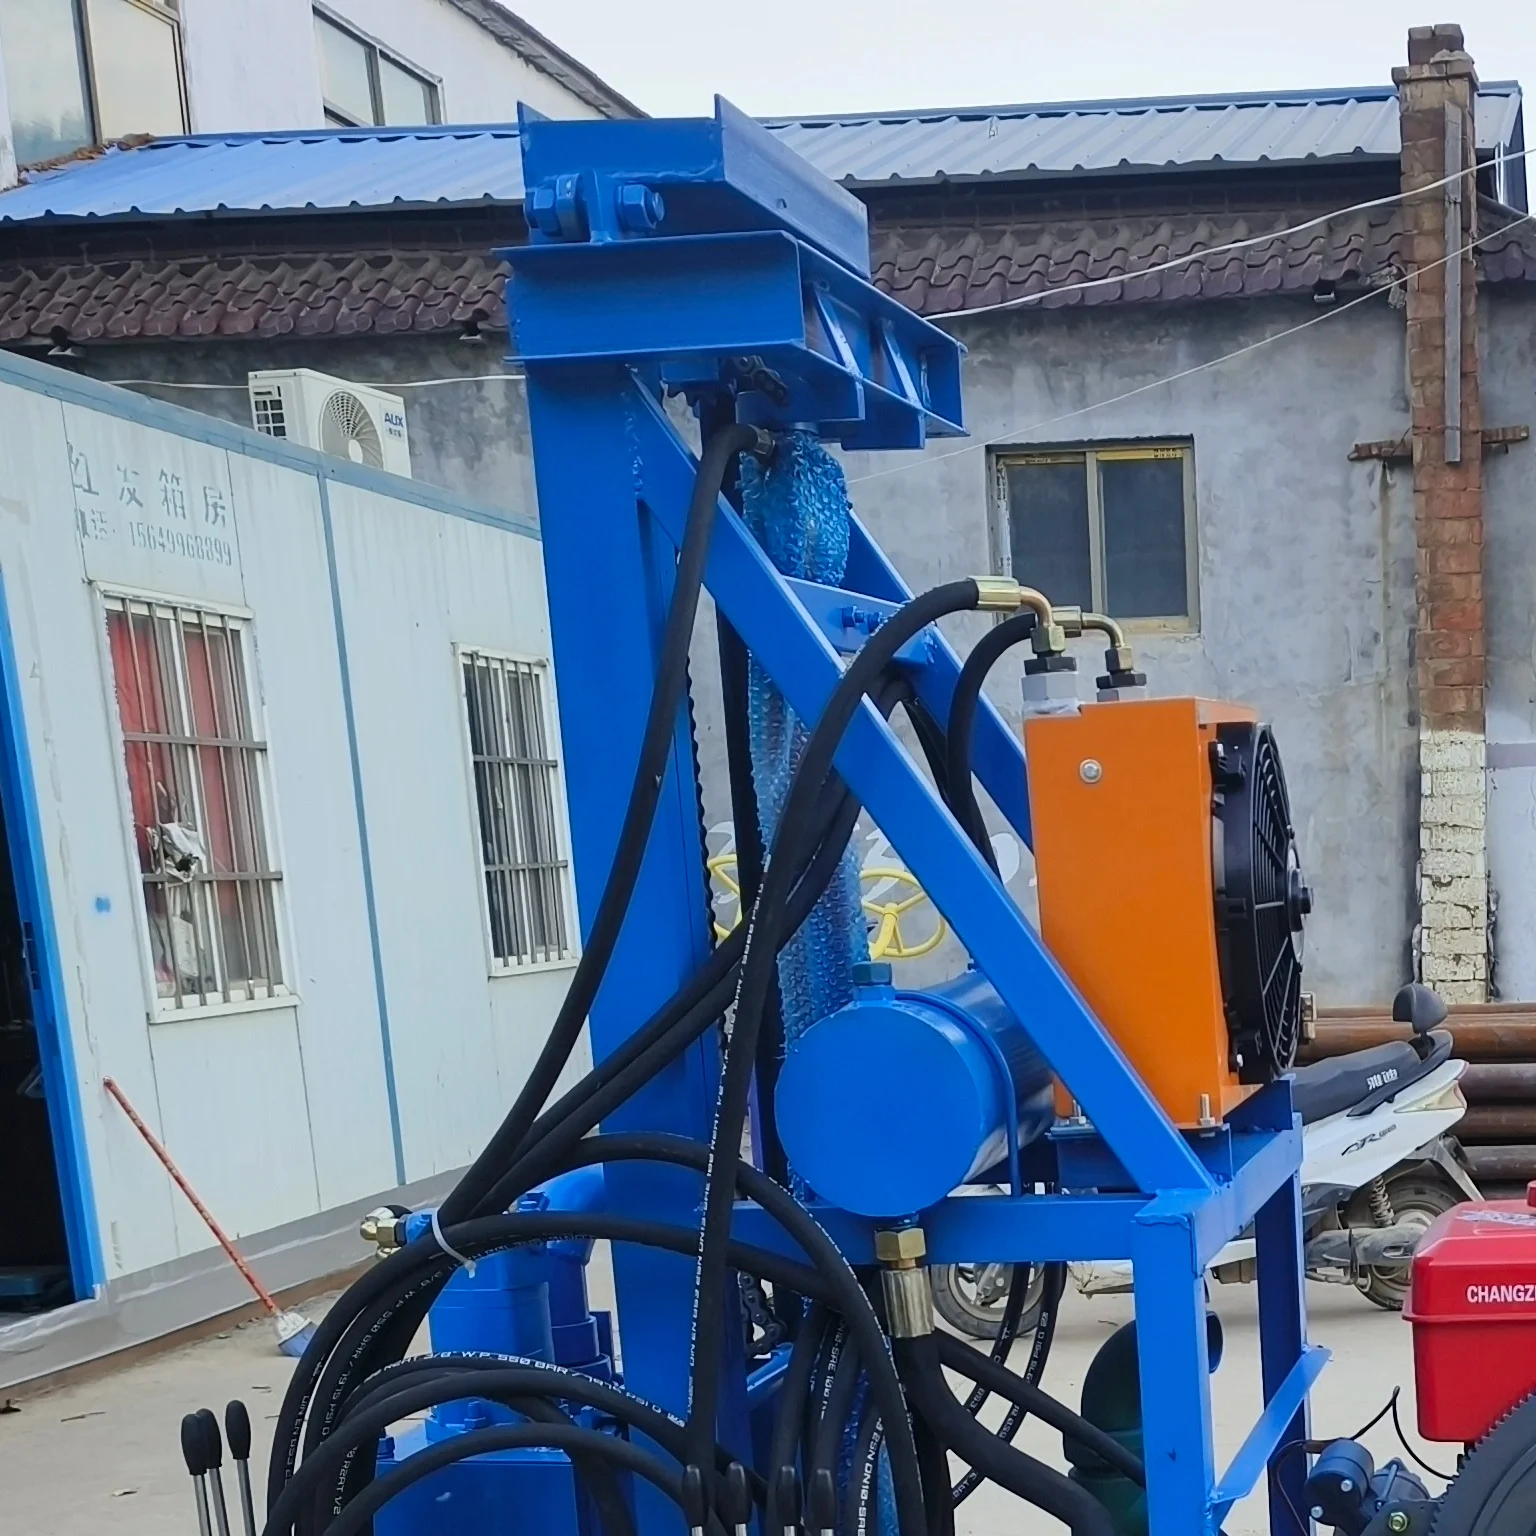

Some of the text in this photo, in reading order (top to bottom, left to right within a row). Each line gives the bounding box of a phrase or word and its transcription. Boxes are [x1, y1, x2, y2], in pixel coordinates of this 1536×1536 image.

[385, 412, 404, 428] AUX
[497, 1354, 531, 1366] 550
[534, 1360, 569, 1375] BAR
